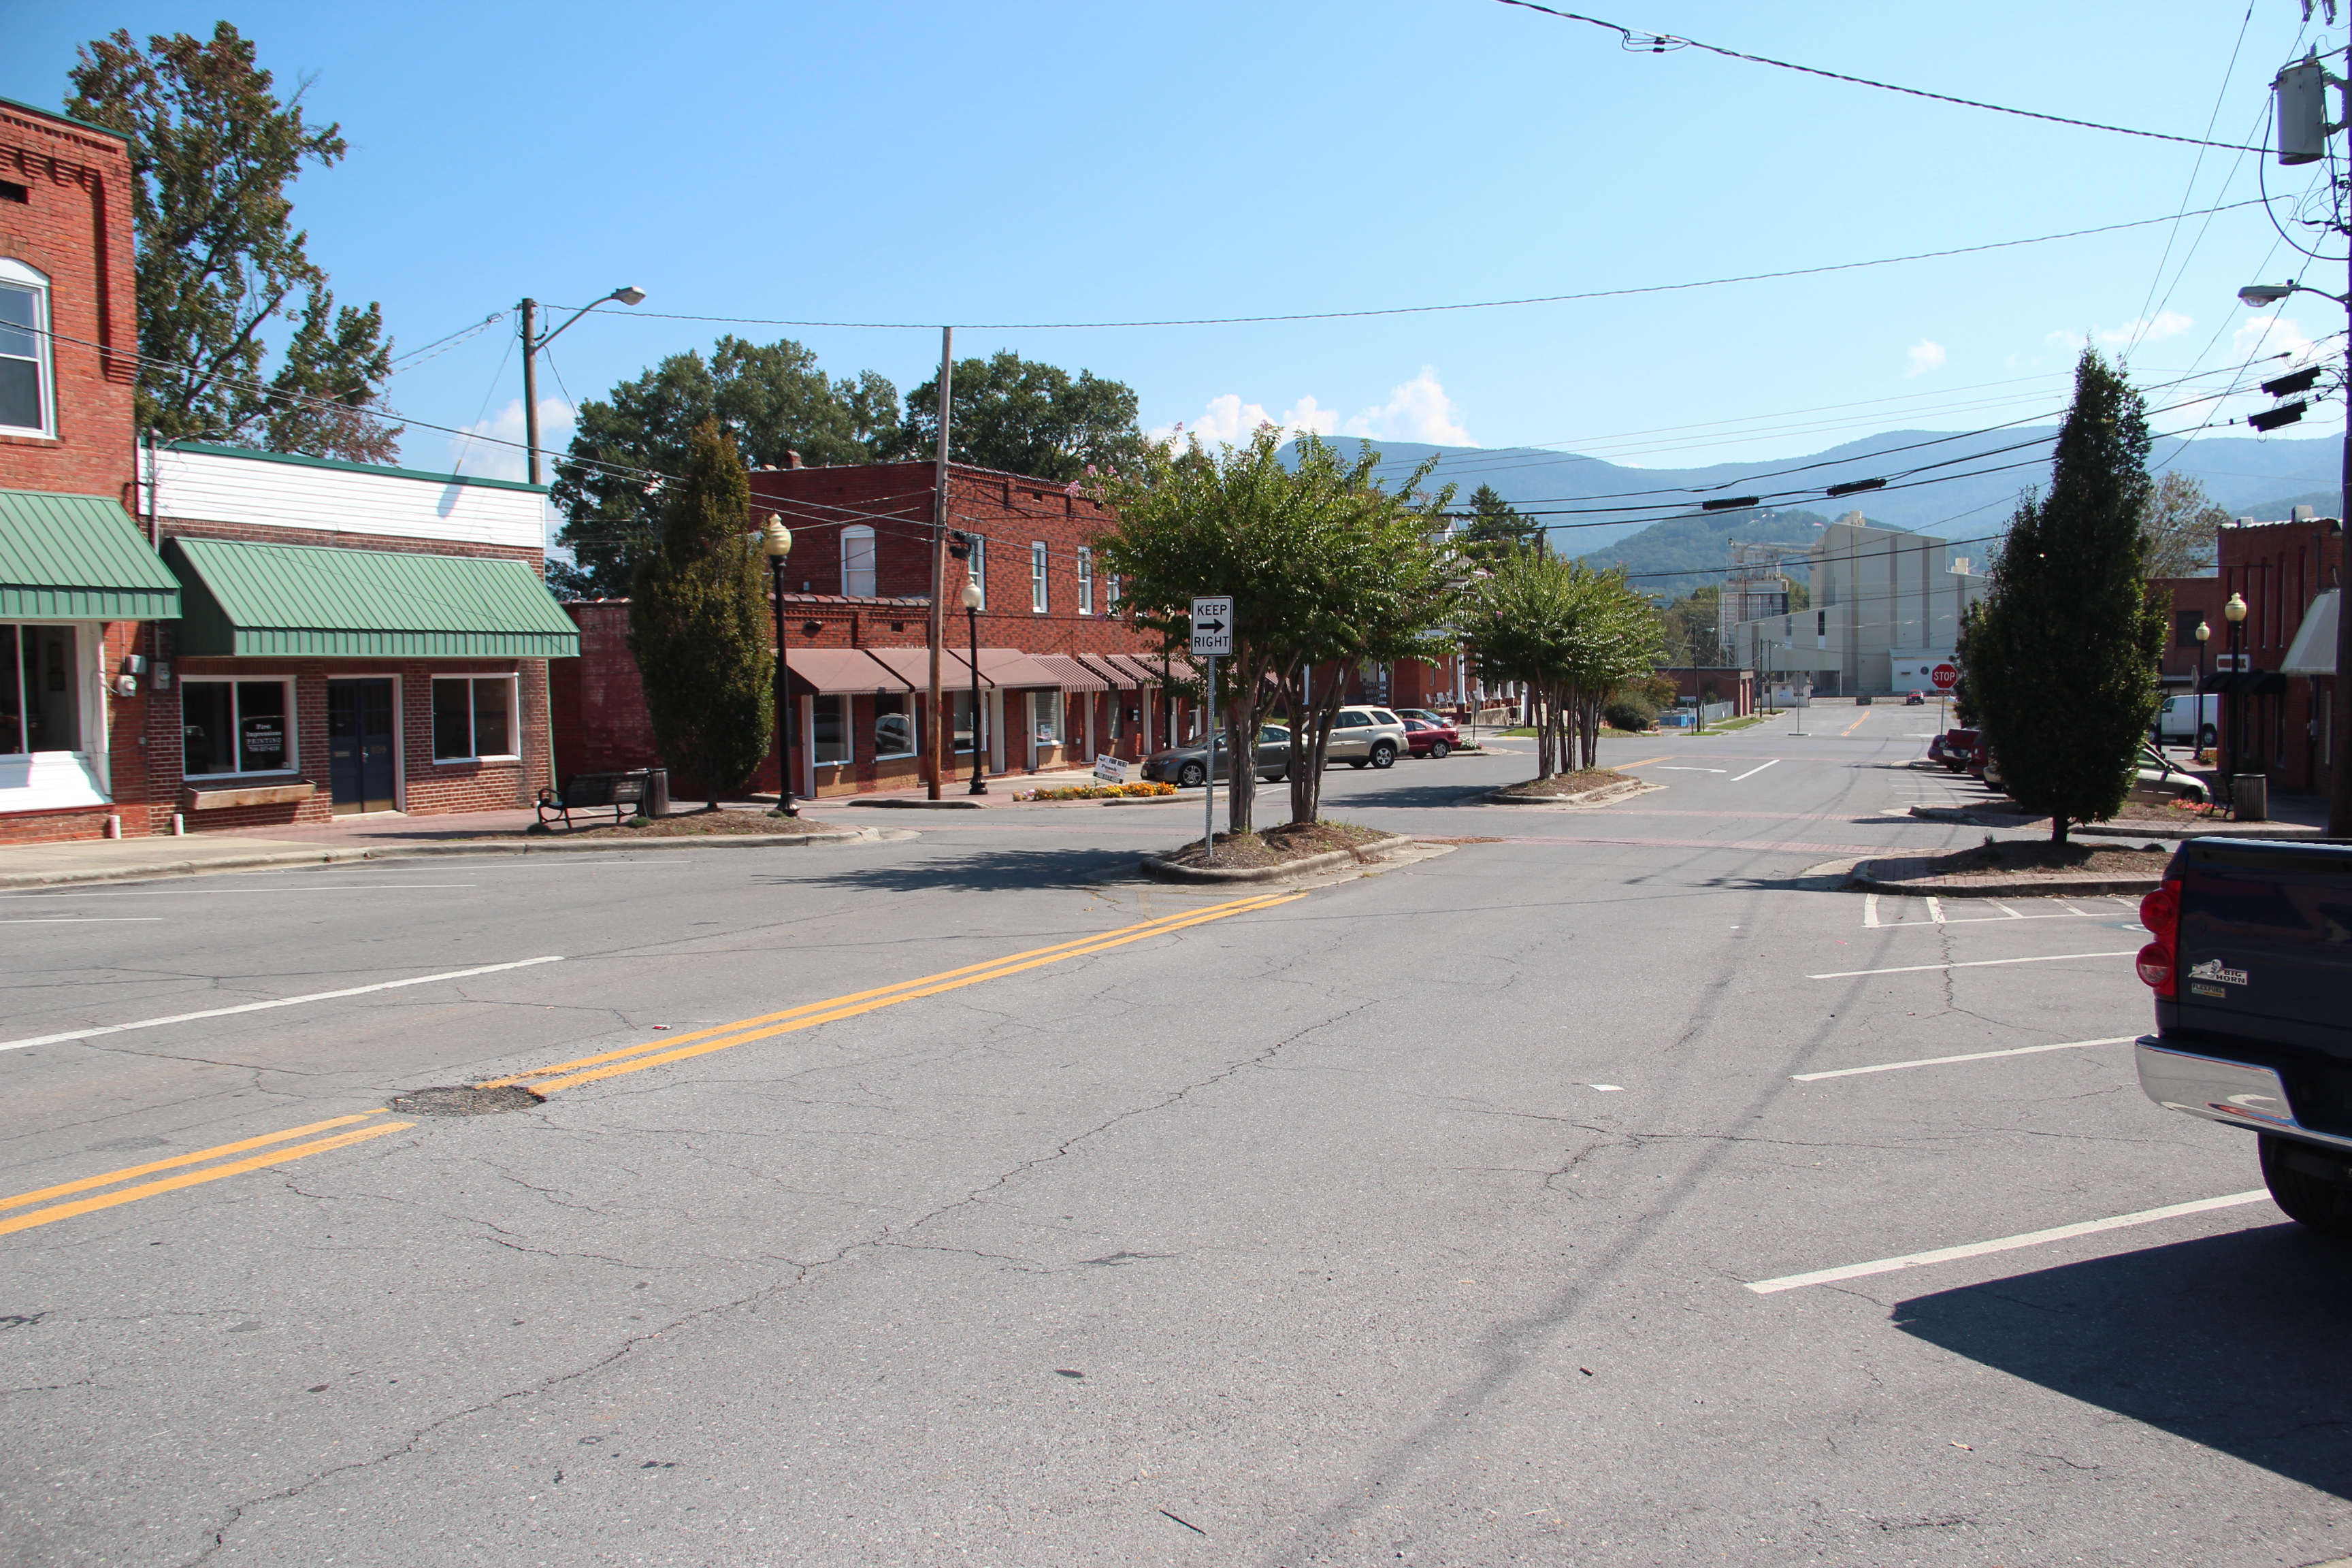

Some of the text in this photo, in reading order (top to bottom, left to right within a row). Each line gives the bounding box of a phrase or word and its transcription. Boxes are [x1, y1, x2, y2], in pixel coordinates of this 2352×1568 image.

[1197, 604, 1227, 616] KEEP
[1194, 636, 1229, 647] RIGHT
[1933, 671, 1955, 681] STOP
[1101, 763, 1117, 772] Peach
[2216, 974, 2245, 984] HORN
[2192, 983, 2223, 994] FLEXFUEL
